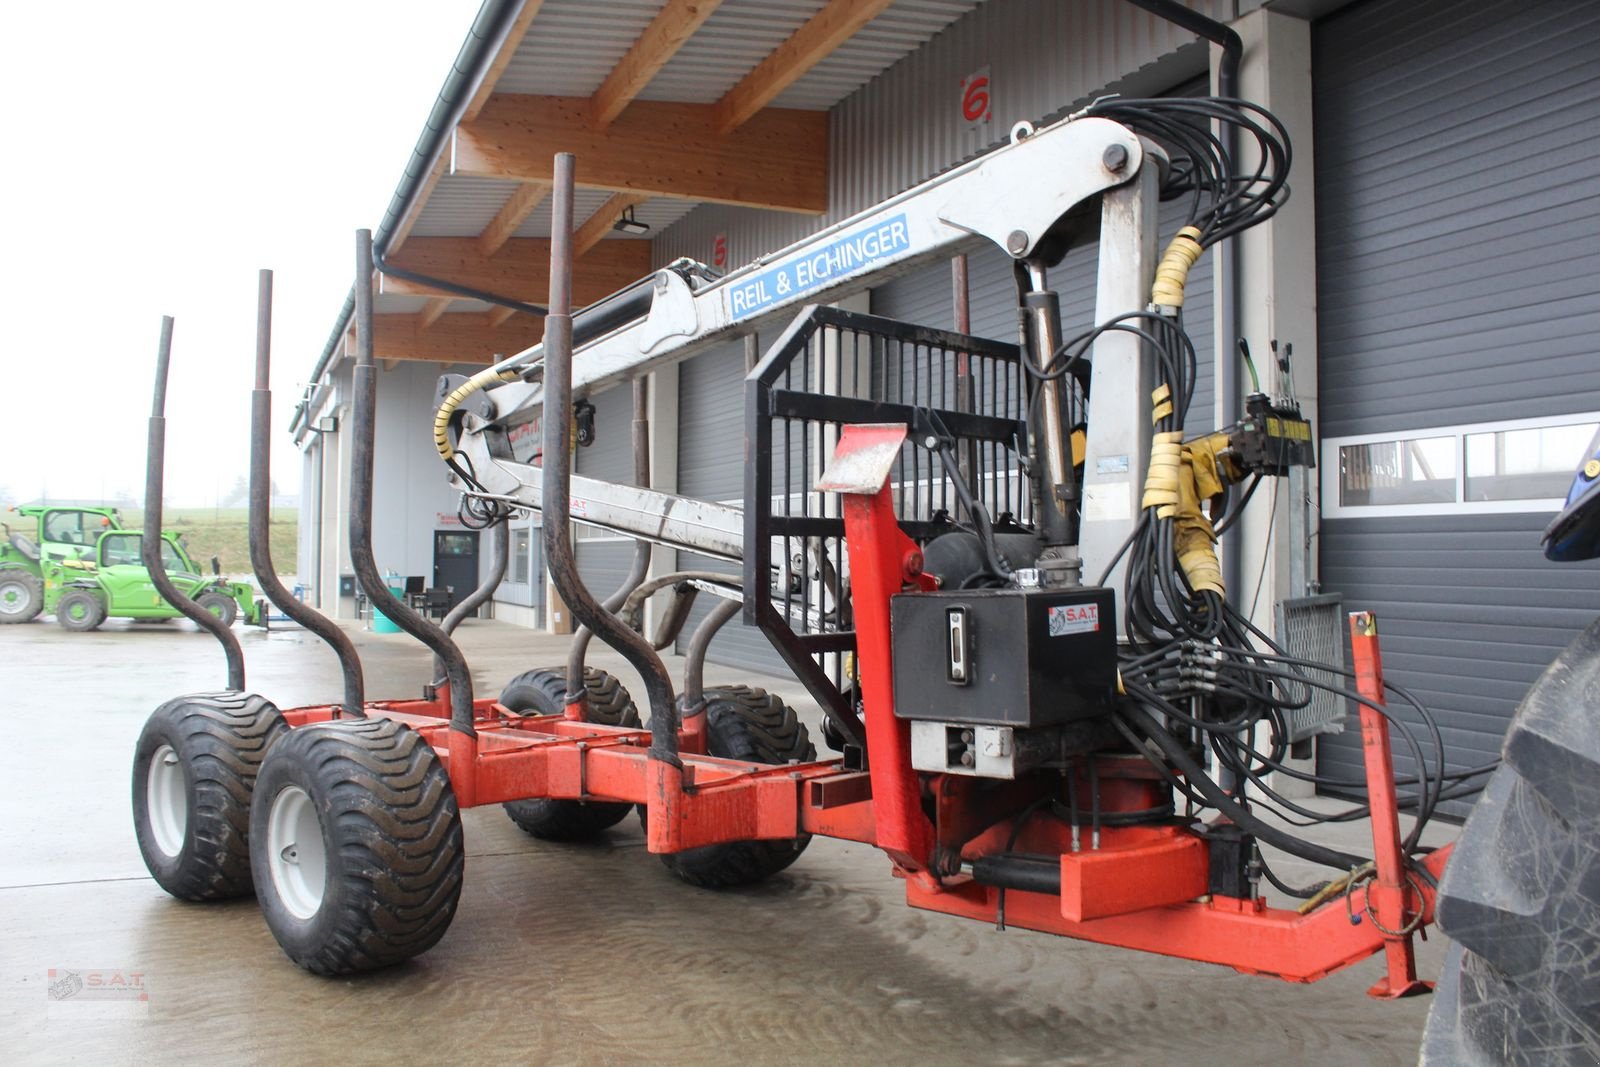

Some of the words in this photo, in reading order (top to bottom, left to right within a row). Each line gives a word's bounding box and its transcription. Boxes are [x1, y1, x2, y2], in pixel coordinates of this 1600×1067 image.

[962, 76, 989, 122] 6
[714, 237, 727, 266] 5
[733, 280, 771, 314] REIL
[776, 271, 792, 295] &
[796, 220, 908, 288] EICHINGER
[1066, 606, 1097, 621] S.A.T.
